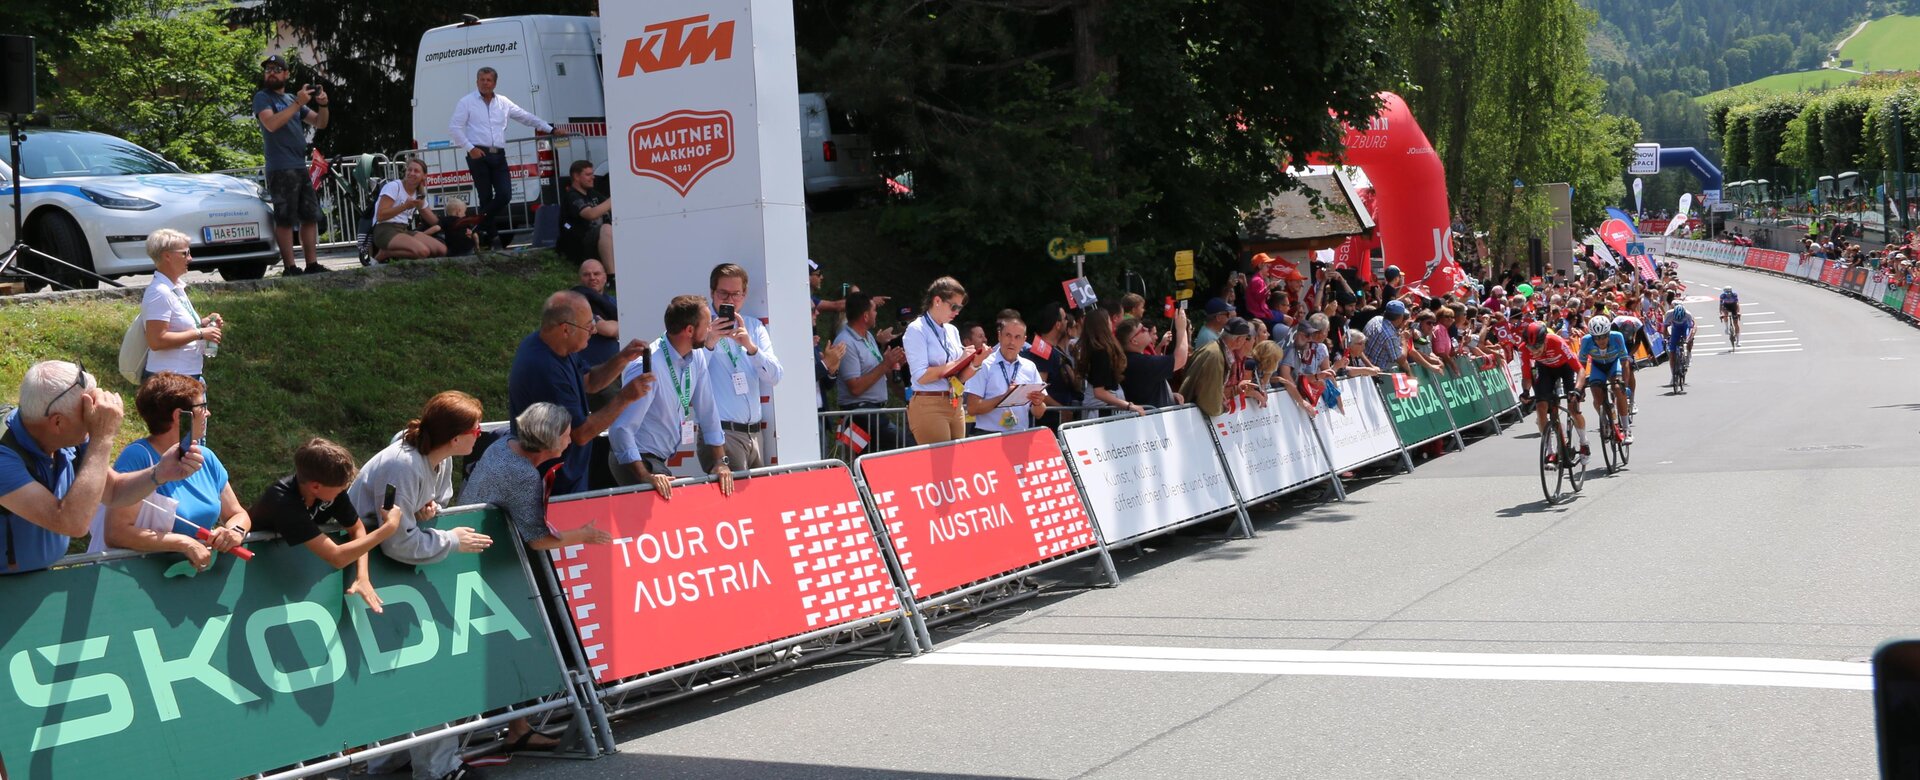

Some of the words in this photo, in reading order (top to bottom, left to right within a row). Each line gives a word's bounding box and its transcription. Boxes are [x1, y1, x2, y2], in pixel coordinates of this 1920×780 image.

[425, 40, 517, 62] computerauswertung.at
[618, 14, 735, 78] KTM
[639, 123, 724, 151] MAUTNER
[651, 144, 712, 163] MARKHOF
[1340, 135, 1388, 149] ALZBURG
[673, 164, 691, 174] 1841
[1094, 436, 1173, 463] Bundesministerium
[911, 477, 971, 510] TOUR
[973, 470, 999, 496] OF
[1114, 486, 1161, 512] öffentlicher
[1161, 480, 1188, 499] Dienst
[1190, 474, 1204, 491] und
[1202, 471, 1224, 490] Sport
[929, 503, 1014, 545] AUSTRIA
[613, 526, 708, 567] TOUR
[716, 518, 755, 550] OF
[634, 559, 772, 613] AUSTRIA
